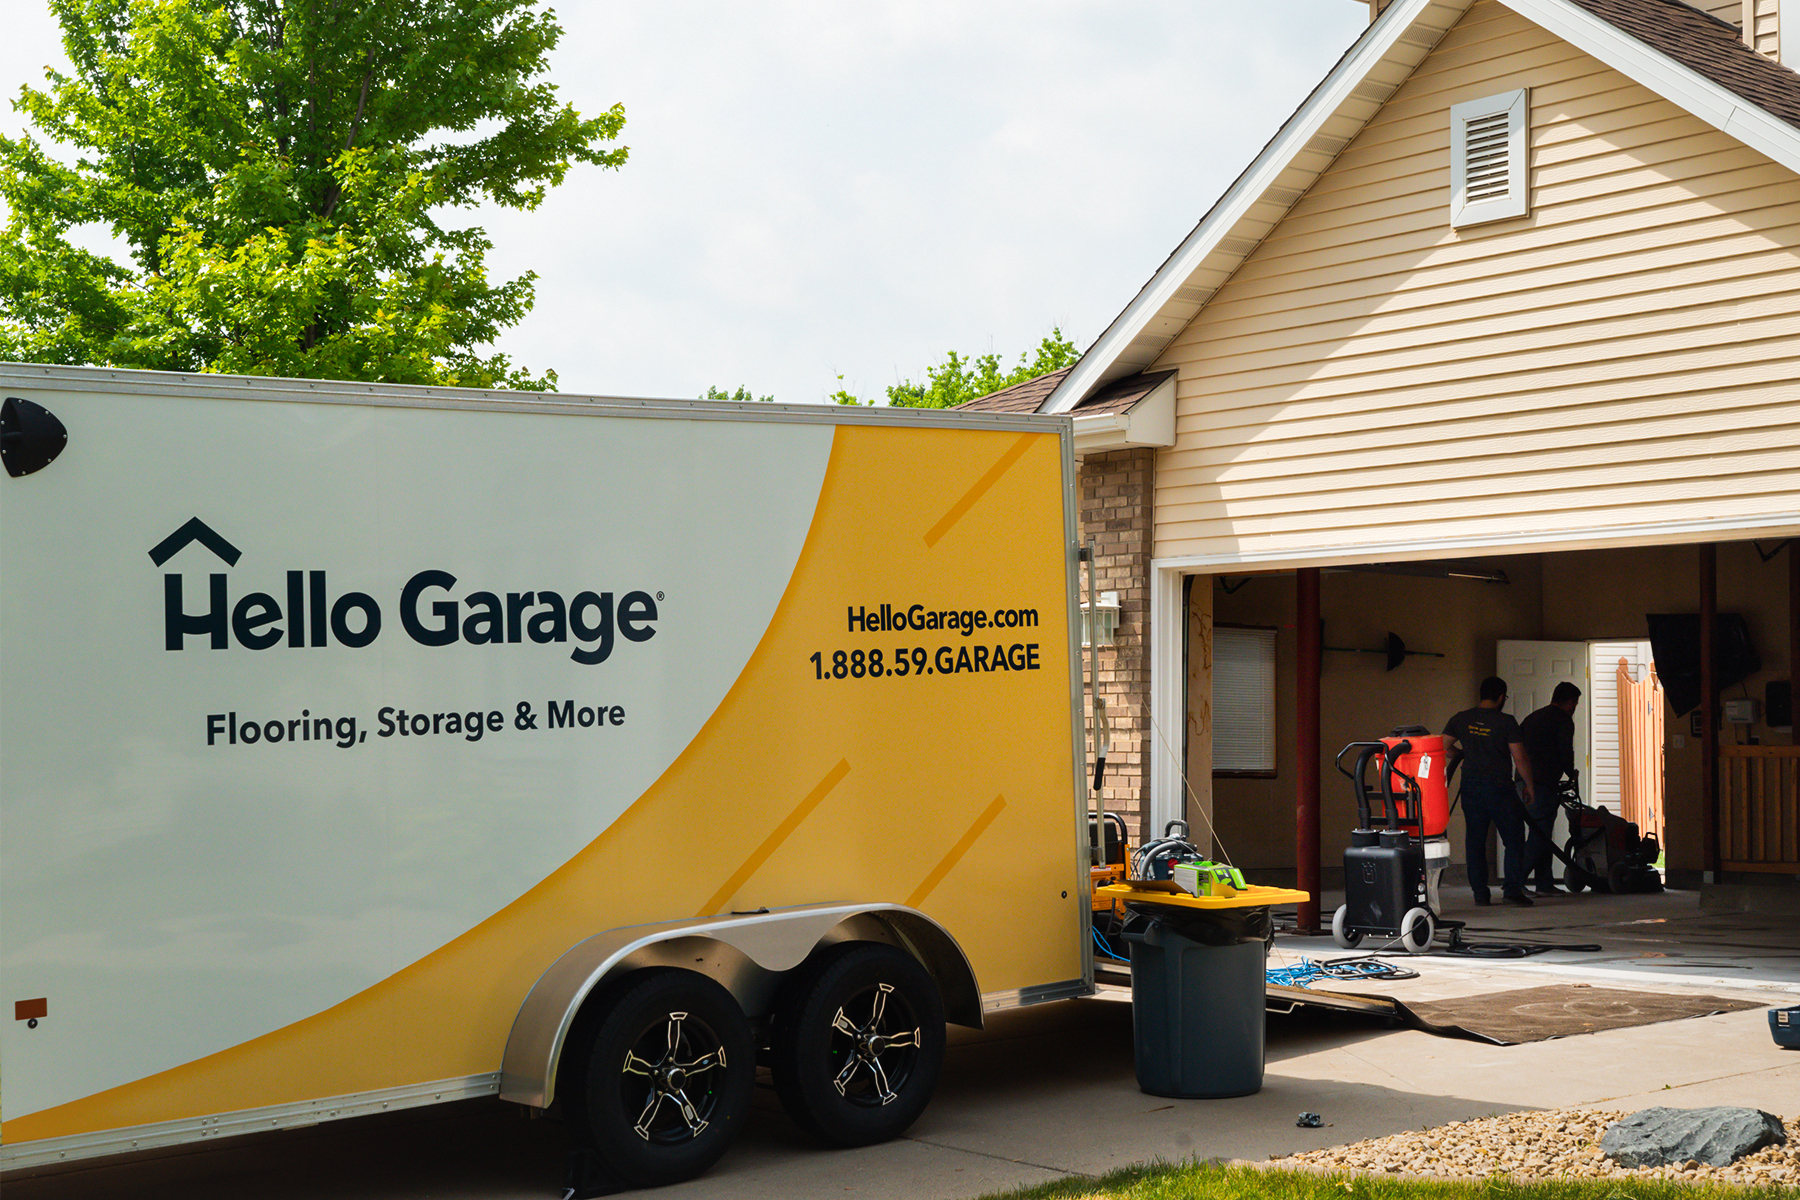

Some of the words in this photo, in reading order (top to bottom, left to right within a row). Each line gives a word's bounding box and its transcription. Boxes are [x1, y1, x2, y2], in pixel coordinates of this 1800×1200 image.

[164, 569, 382, 651] Hello
[847, 603, 1039, 637] HelloGarage.com
[809, 643, 1041, 680] 1.888.59.GARAGE
[206, 709, 368, 749] Flooring,
[377, 706, 505, 742] Storage
[514, 701, 539, 731] &
[547, 699, 626, 729] More
